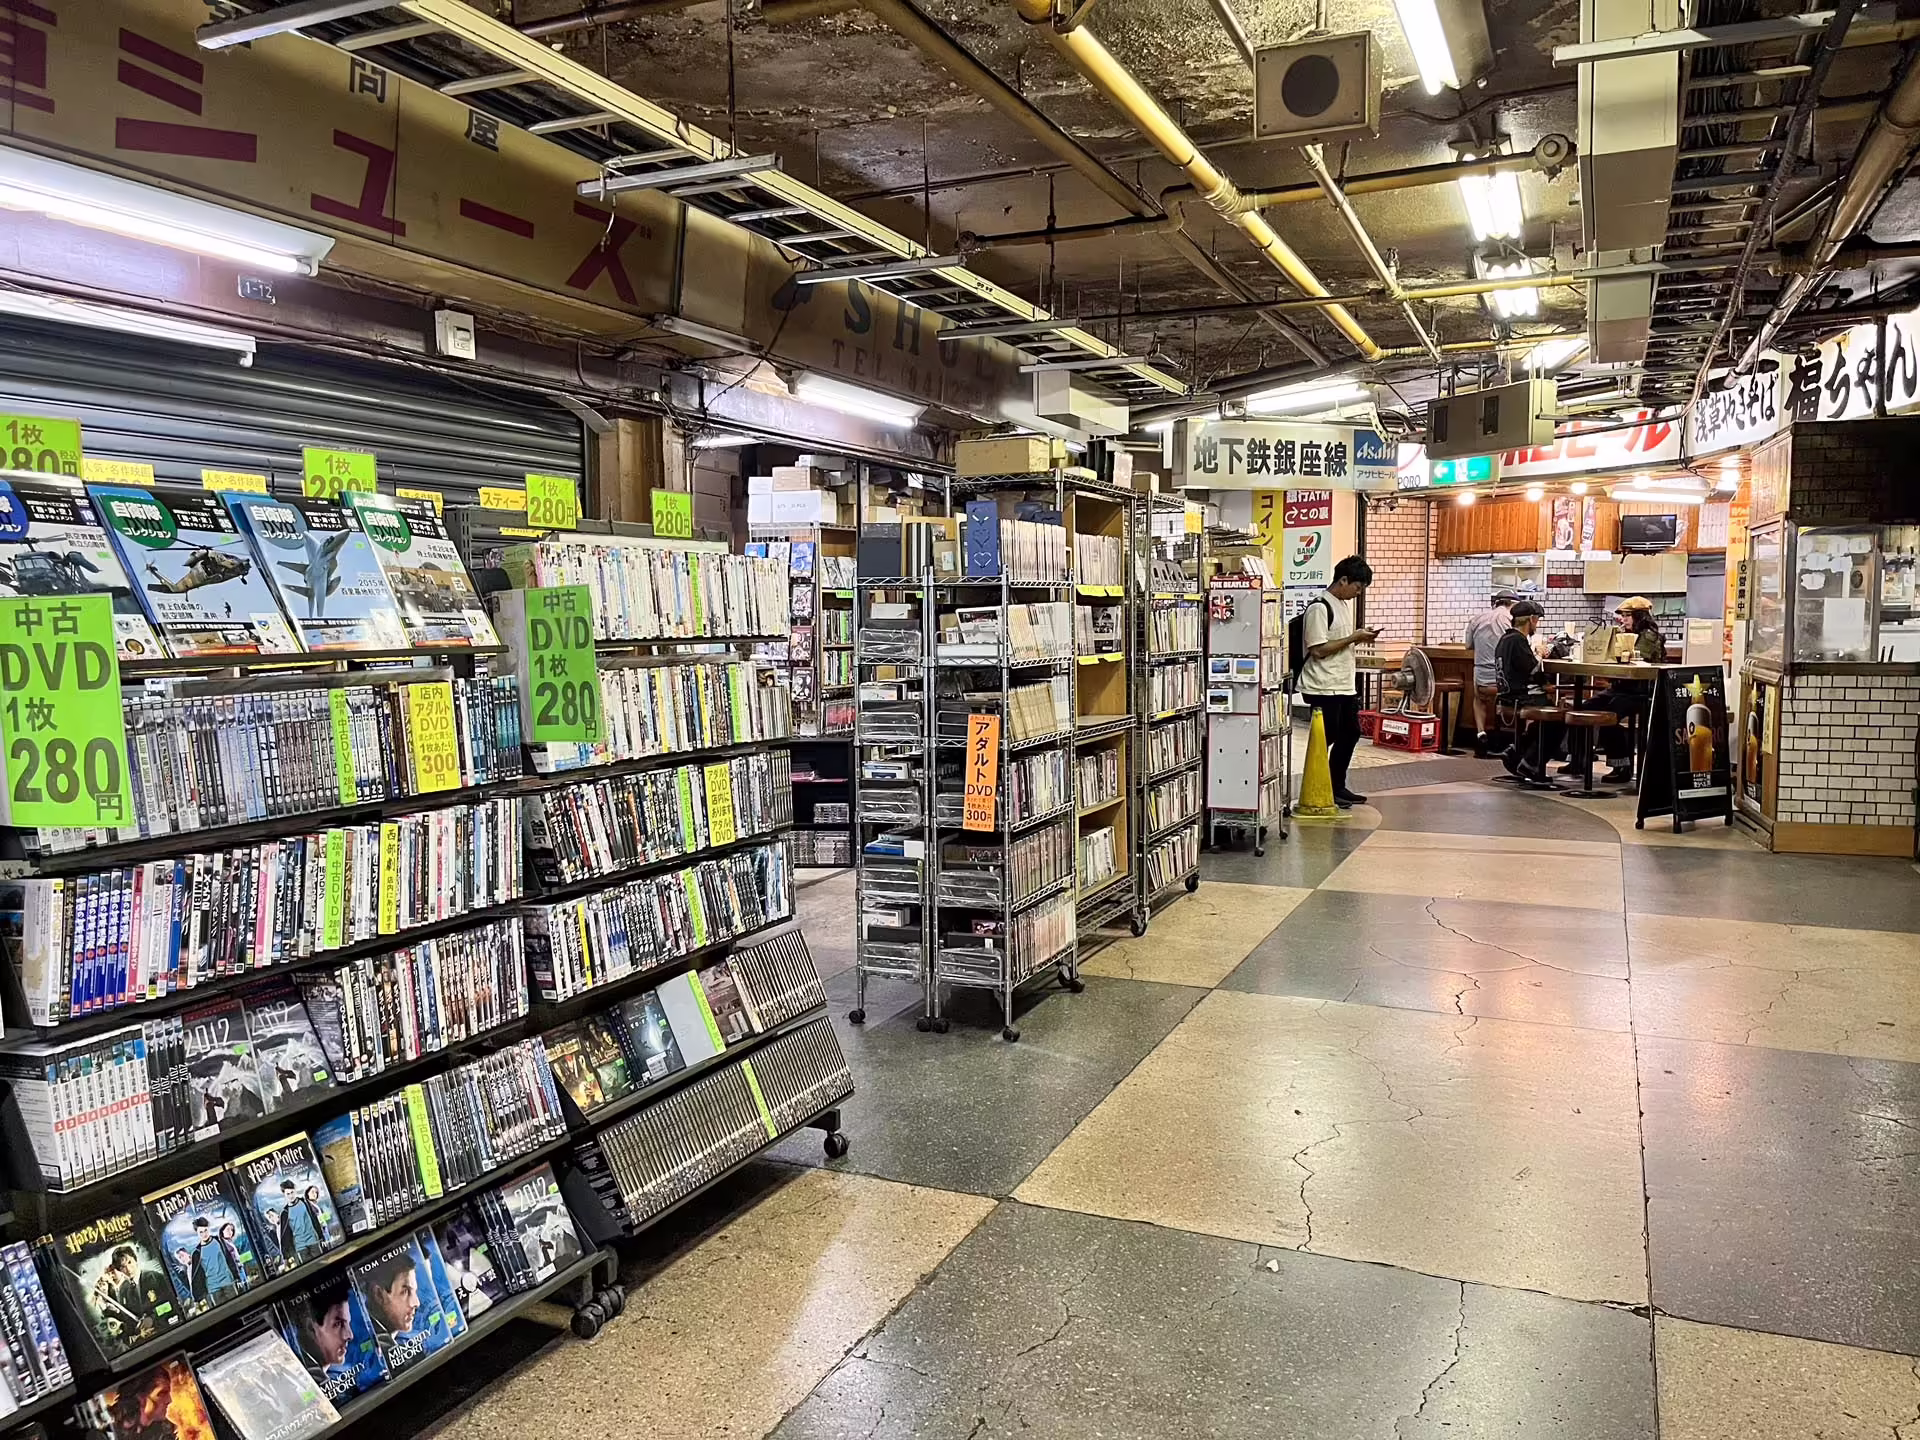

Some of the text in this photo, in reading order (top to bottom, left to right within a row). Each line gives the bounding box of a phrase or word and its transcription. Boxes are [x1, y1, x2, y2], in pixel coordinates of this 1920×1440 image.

[244, 280, 273, 299] 1-12
[1784, 322, 1918, 421] 福ちゃん
[1694, 373, 1780, 443] 浅草やきそば
[6, 419, 45, 446] 1枚
[1193, 435, 1348, 478] 地下鉄銀座線
[1356, 440, 1396, 460] Asahi
[325, 454, 351, 475] 1枚
[1356, 469, 1397, 479] アサヒビール
[539, 478, 559, 495] 1枚
[110, 500, 163, 521] 自衛隊
[663, 493, 679, 509] 1枚
[249, 505, 297, 524] 自衛隊
[363, 511, 401, 528] 自衛隊
[529, 497, 575, 526] 280円
[1299, 506, 1329, 520] この裏
[123, 517, 163, 532] DVD
[261, 520, 297, 533] DVD
[373, 525, 401, 538] DVD
[655, 509, 691, 535] 280円
[122, 527, 172, 539] コレクション
[260, 530, 304, 540] コレクション
[372, 534, 407, 544] コレクション
[1297, 547, 1316, 555] BANK
[1210, 580, 1251, 589] THE BEATLES
[1289, 571, 1324, 580] セブン銀行
[543, 589, 577, 614] 中古
[1738, 576, 1747, 611] 営業中
[14, 601, 82, 637] 中古
[530, 616, 590, 651] DVD
[0, 641, 112, 693] DVD
[534, 653, 569, 679] 1枚
[420, 686, 443, 700] 店内
[6, 696, 59, 733] 1枚
[414, 700, 451, 717] アダルト
[420, 716, 449, 732] DVD
[1675, 727, 1725, 745] SARO
[338, 718, 353, 774] 中古DVD
[420, 742, 454, 754] 1枚あたり
[974, 721, 990, 783] アダルト
[421, 752, 456, 775] 300
[435, 774, 446, 788] 円
[707, 768, 728, 780] アダルト
[710, 778, 728, 793] DVD
[967, 784, 993, 797] DVD
[711, 792, 729, 806] 店内に
[711, 805, 731, 818] あります
[966, 809, 993, 823] 300円
[712, 819, 732, 831] アダルト
[715, 829, 732, 843] DVD
[330, 859, 342, 917] 中古DVD
[386, 828, 396, 932] 西部劇 店内にあります
[183, 1018, 230, 1059] 2012
[416, 1112, 434, 1166] 中古DVD
[247, 1144, 304, 1185] Harry Potter
[155, 1180, 220, 1223] Harry Potter
[514, 1177, 548, 1212] 2012
[65, 1213, 134, 1255] Harry Potter
[359, 1242, 413, 1275] TOM CRUISE
[290, 1288, 312, 1307] TOM
[388, 1328, 434, 1362] MINORITY
[389, 1343, 424, 1371] REPORT
